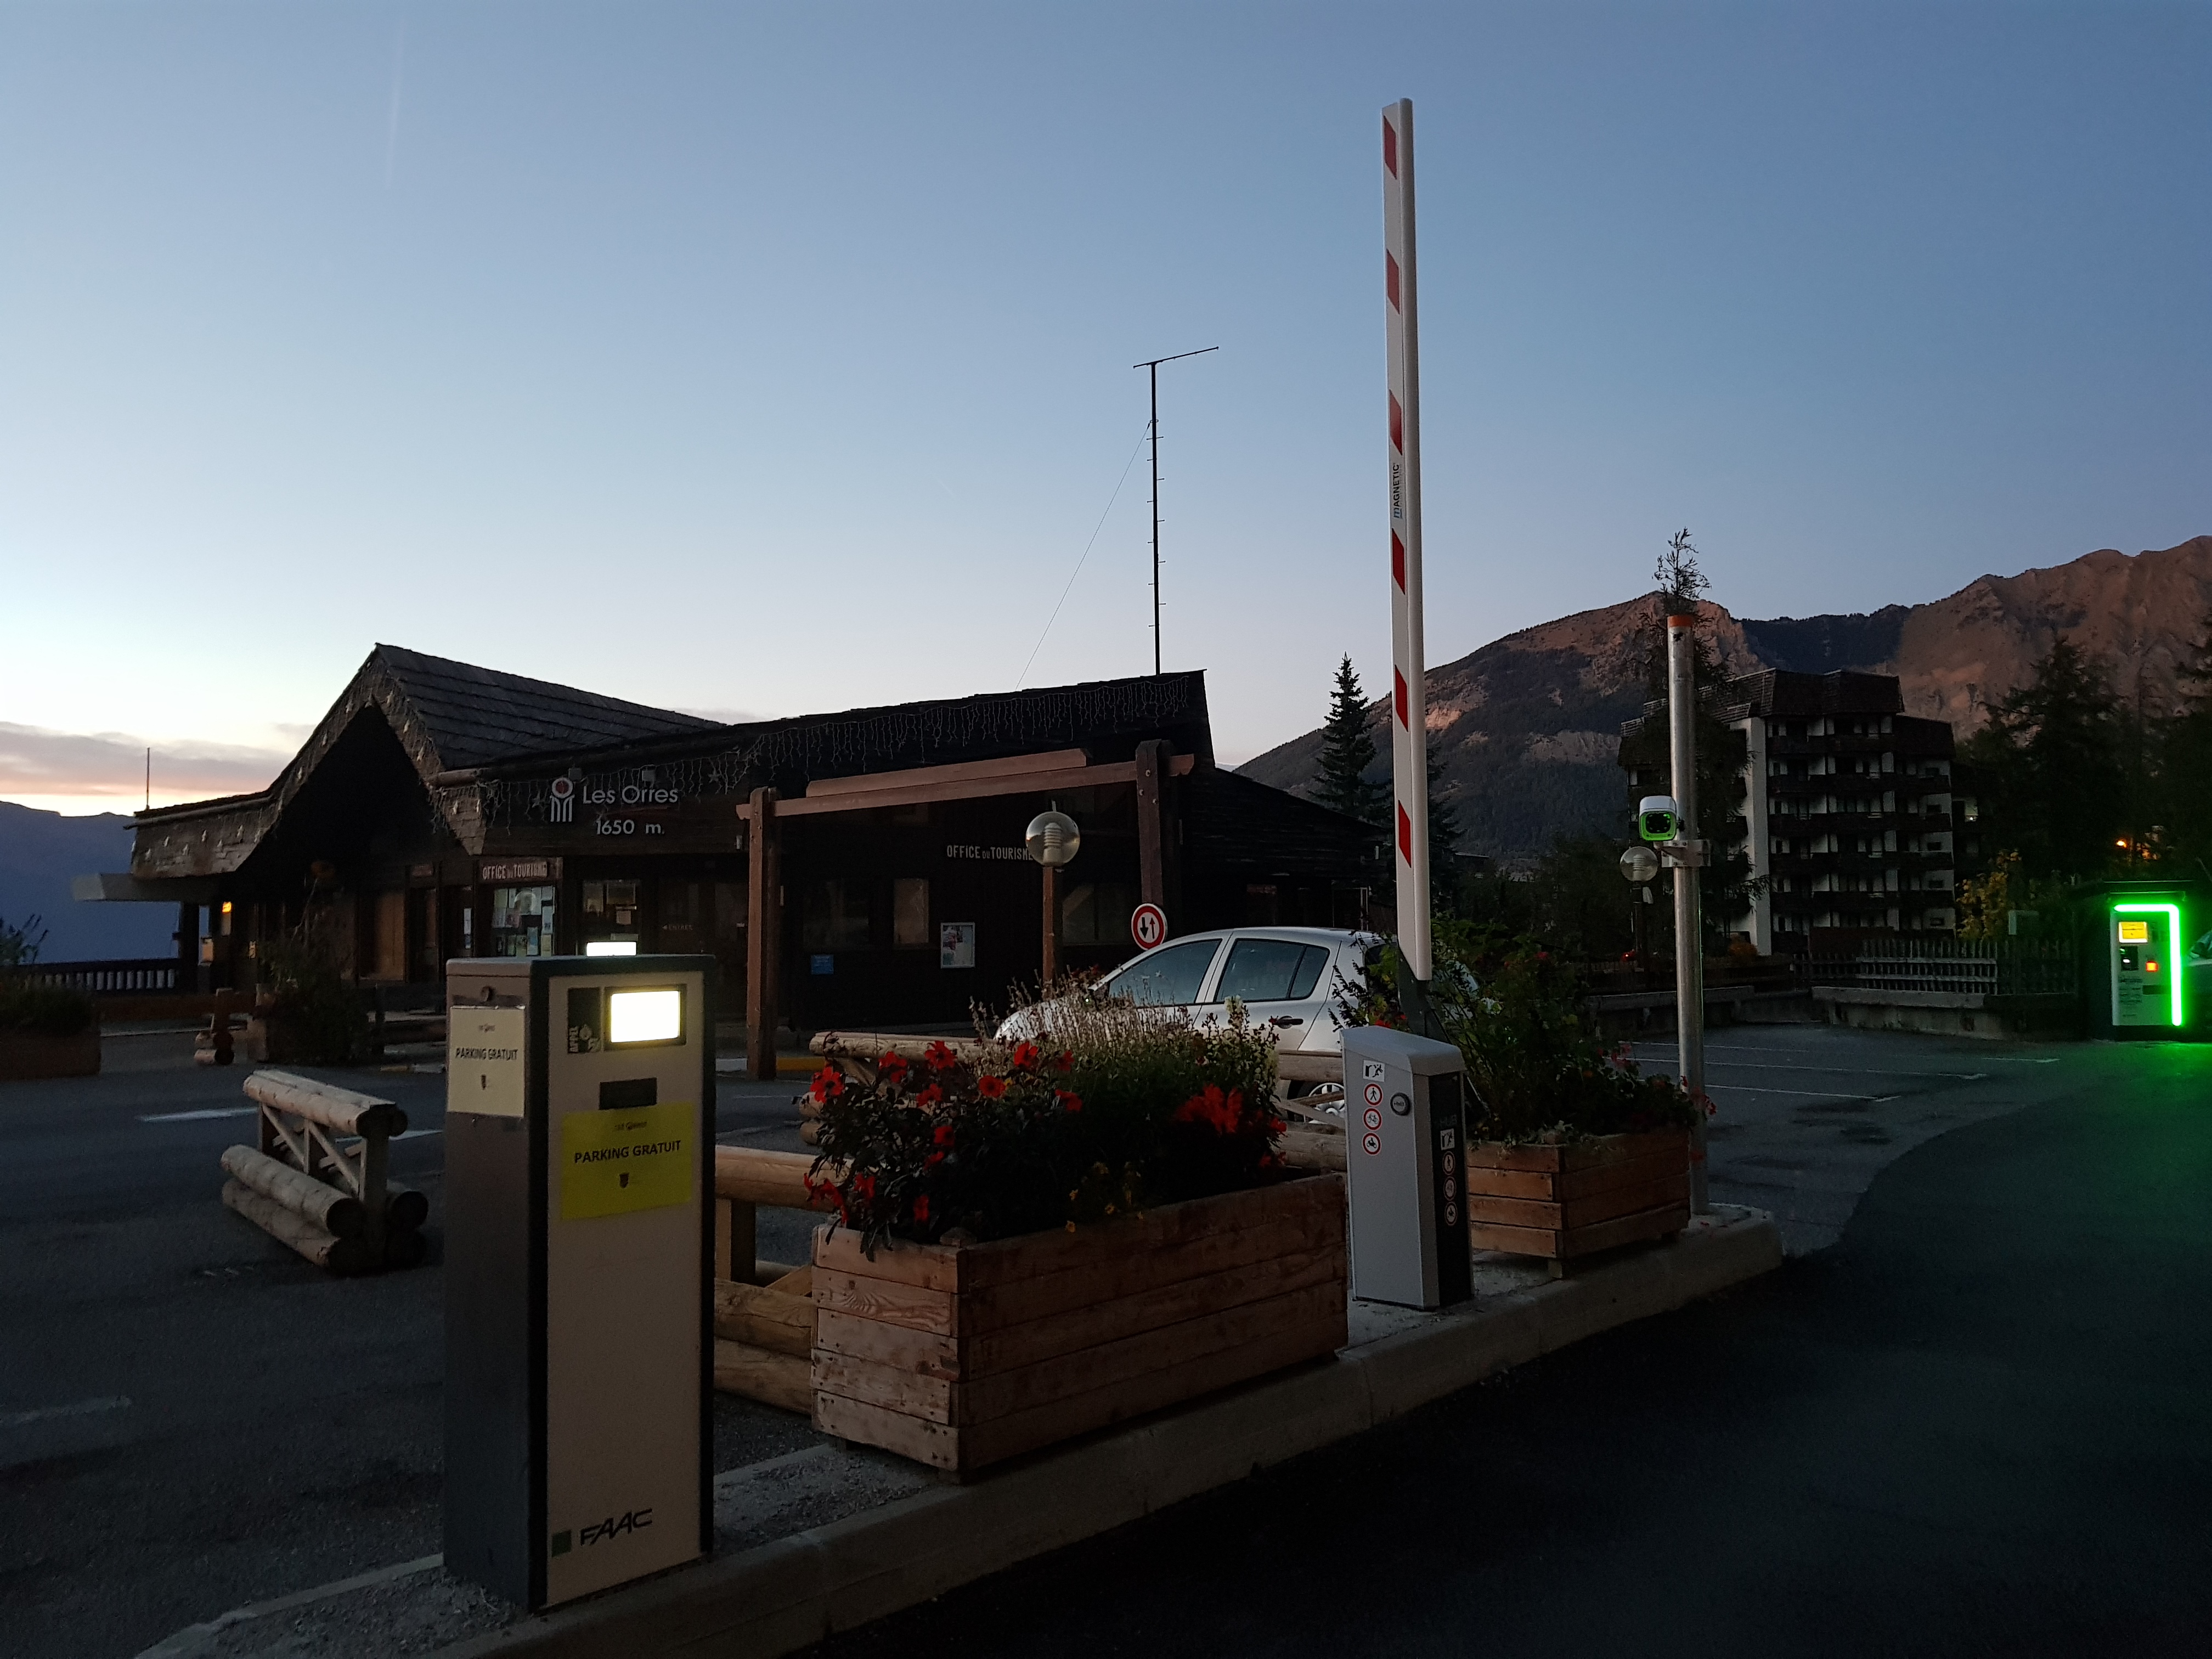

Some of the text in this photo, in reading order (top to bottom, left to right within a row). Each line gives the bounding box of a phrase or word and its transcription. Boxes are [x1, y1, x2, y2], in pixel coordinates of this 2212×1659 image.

[583, 785, 679, 804] Les Orres
[596, 819, 635, 835] 1650
[946, 844, 981, 859] OFFICE
[482, 865, 507, 880] OFFICE
[488, 1047, 518, 1061] GRATUIT
[575, 1140, 681, 1164] PARKING GRATUIT
[580, 1508, 653, 1546] FAAC
